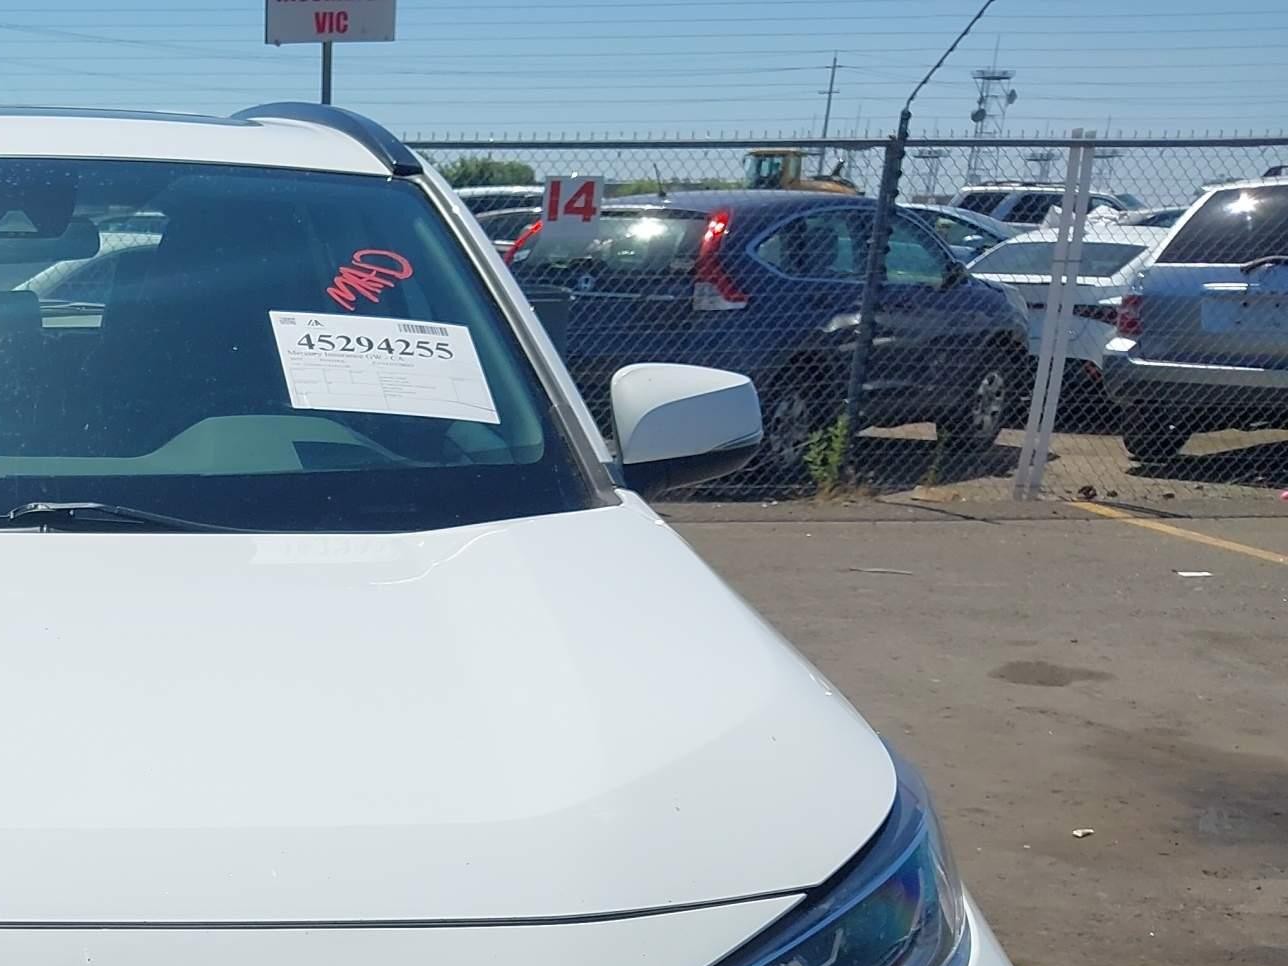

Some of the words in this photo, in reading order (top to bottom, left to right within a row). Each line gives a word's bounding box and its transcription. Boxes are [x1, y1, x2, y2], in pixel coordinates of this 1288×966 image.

[314, 11, 349, 34] VIC
[547, 180, 597, 222] 14
[297, 333, 454, 359] 45294255
